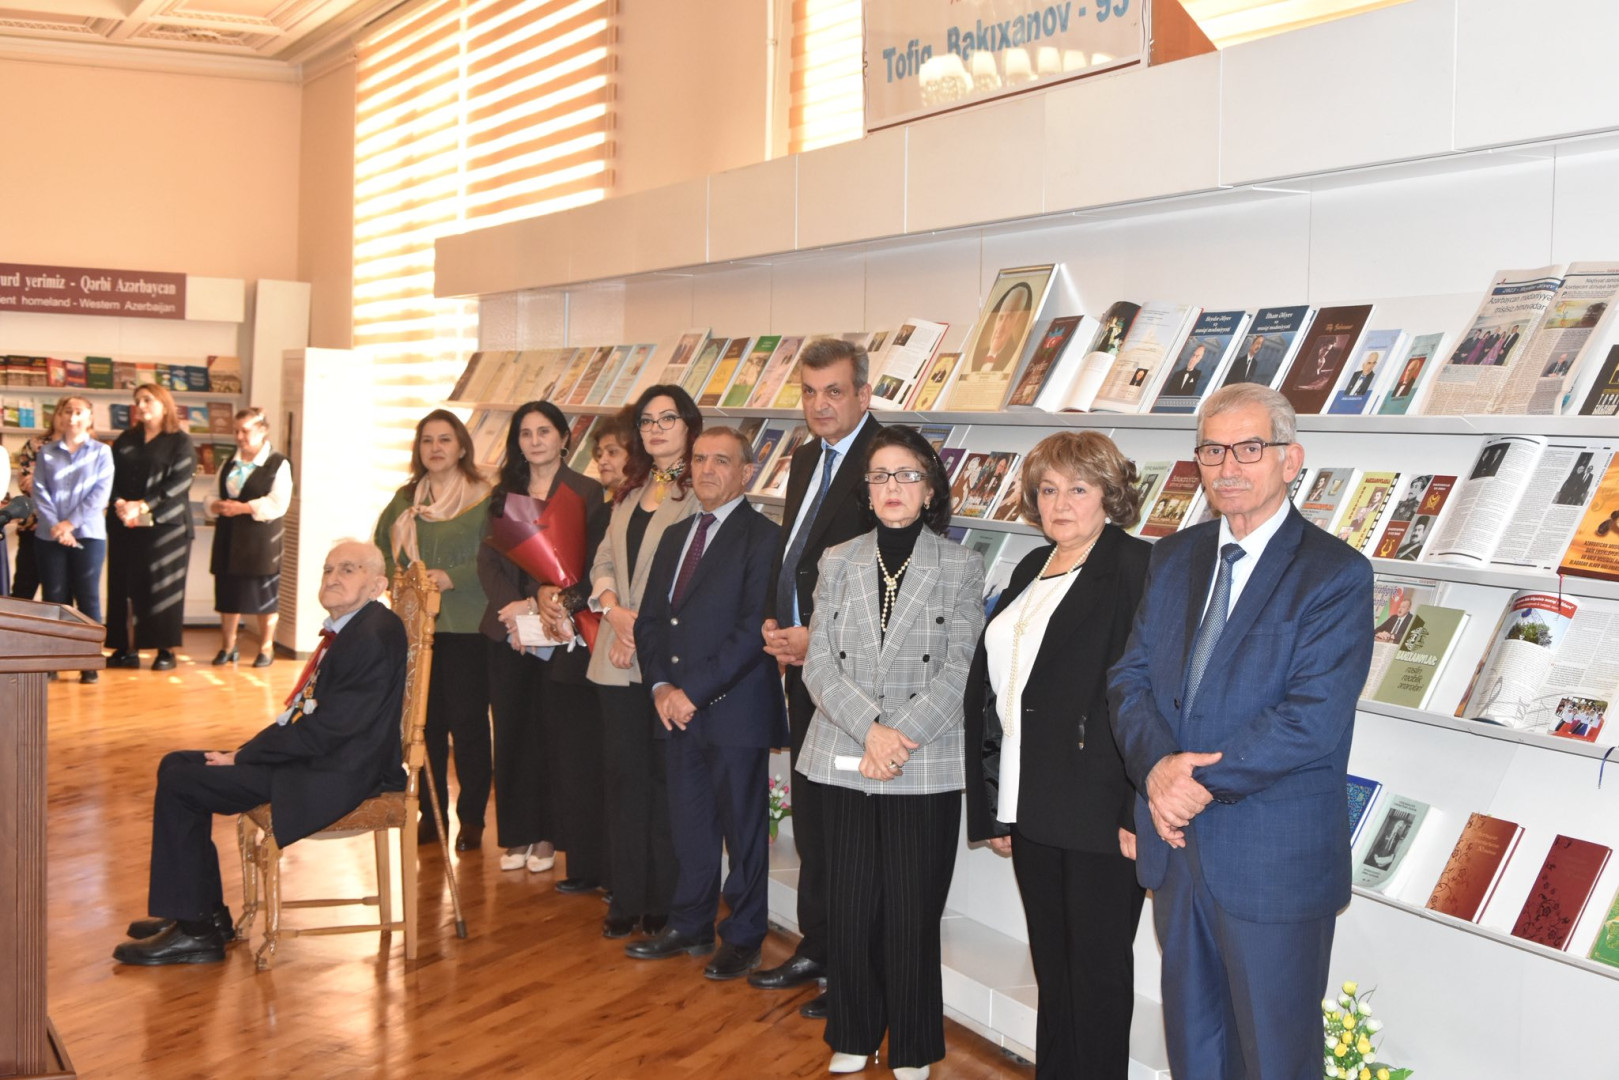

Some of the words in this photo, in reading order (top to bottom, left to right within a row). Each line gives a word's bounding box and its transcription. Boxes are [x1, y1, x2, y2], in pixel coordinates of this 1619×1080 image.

[0, 272, 20, 287] urd
[25, 273, 66, 291] yerimiz
[80, 275, 111, 294] Qərbi
[115, 277, 177, 298] Azərbaycan
[0, 295, 17, 305] ent
[21, 295, 71, 307] homeland
[79, 297, 120, 310] Western
[124, 300, 176, 314] Azerbaijan
